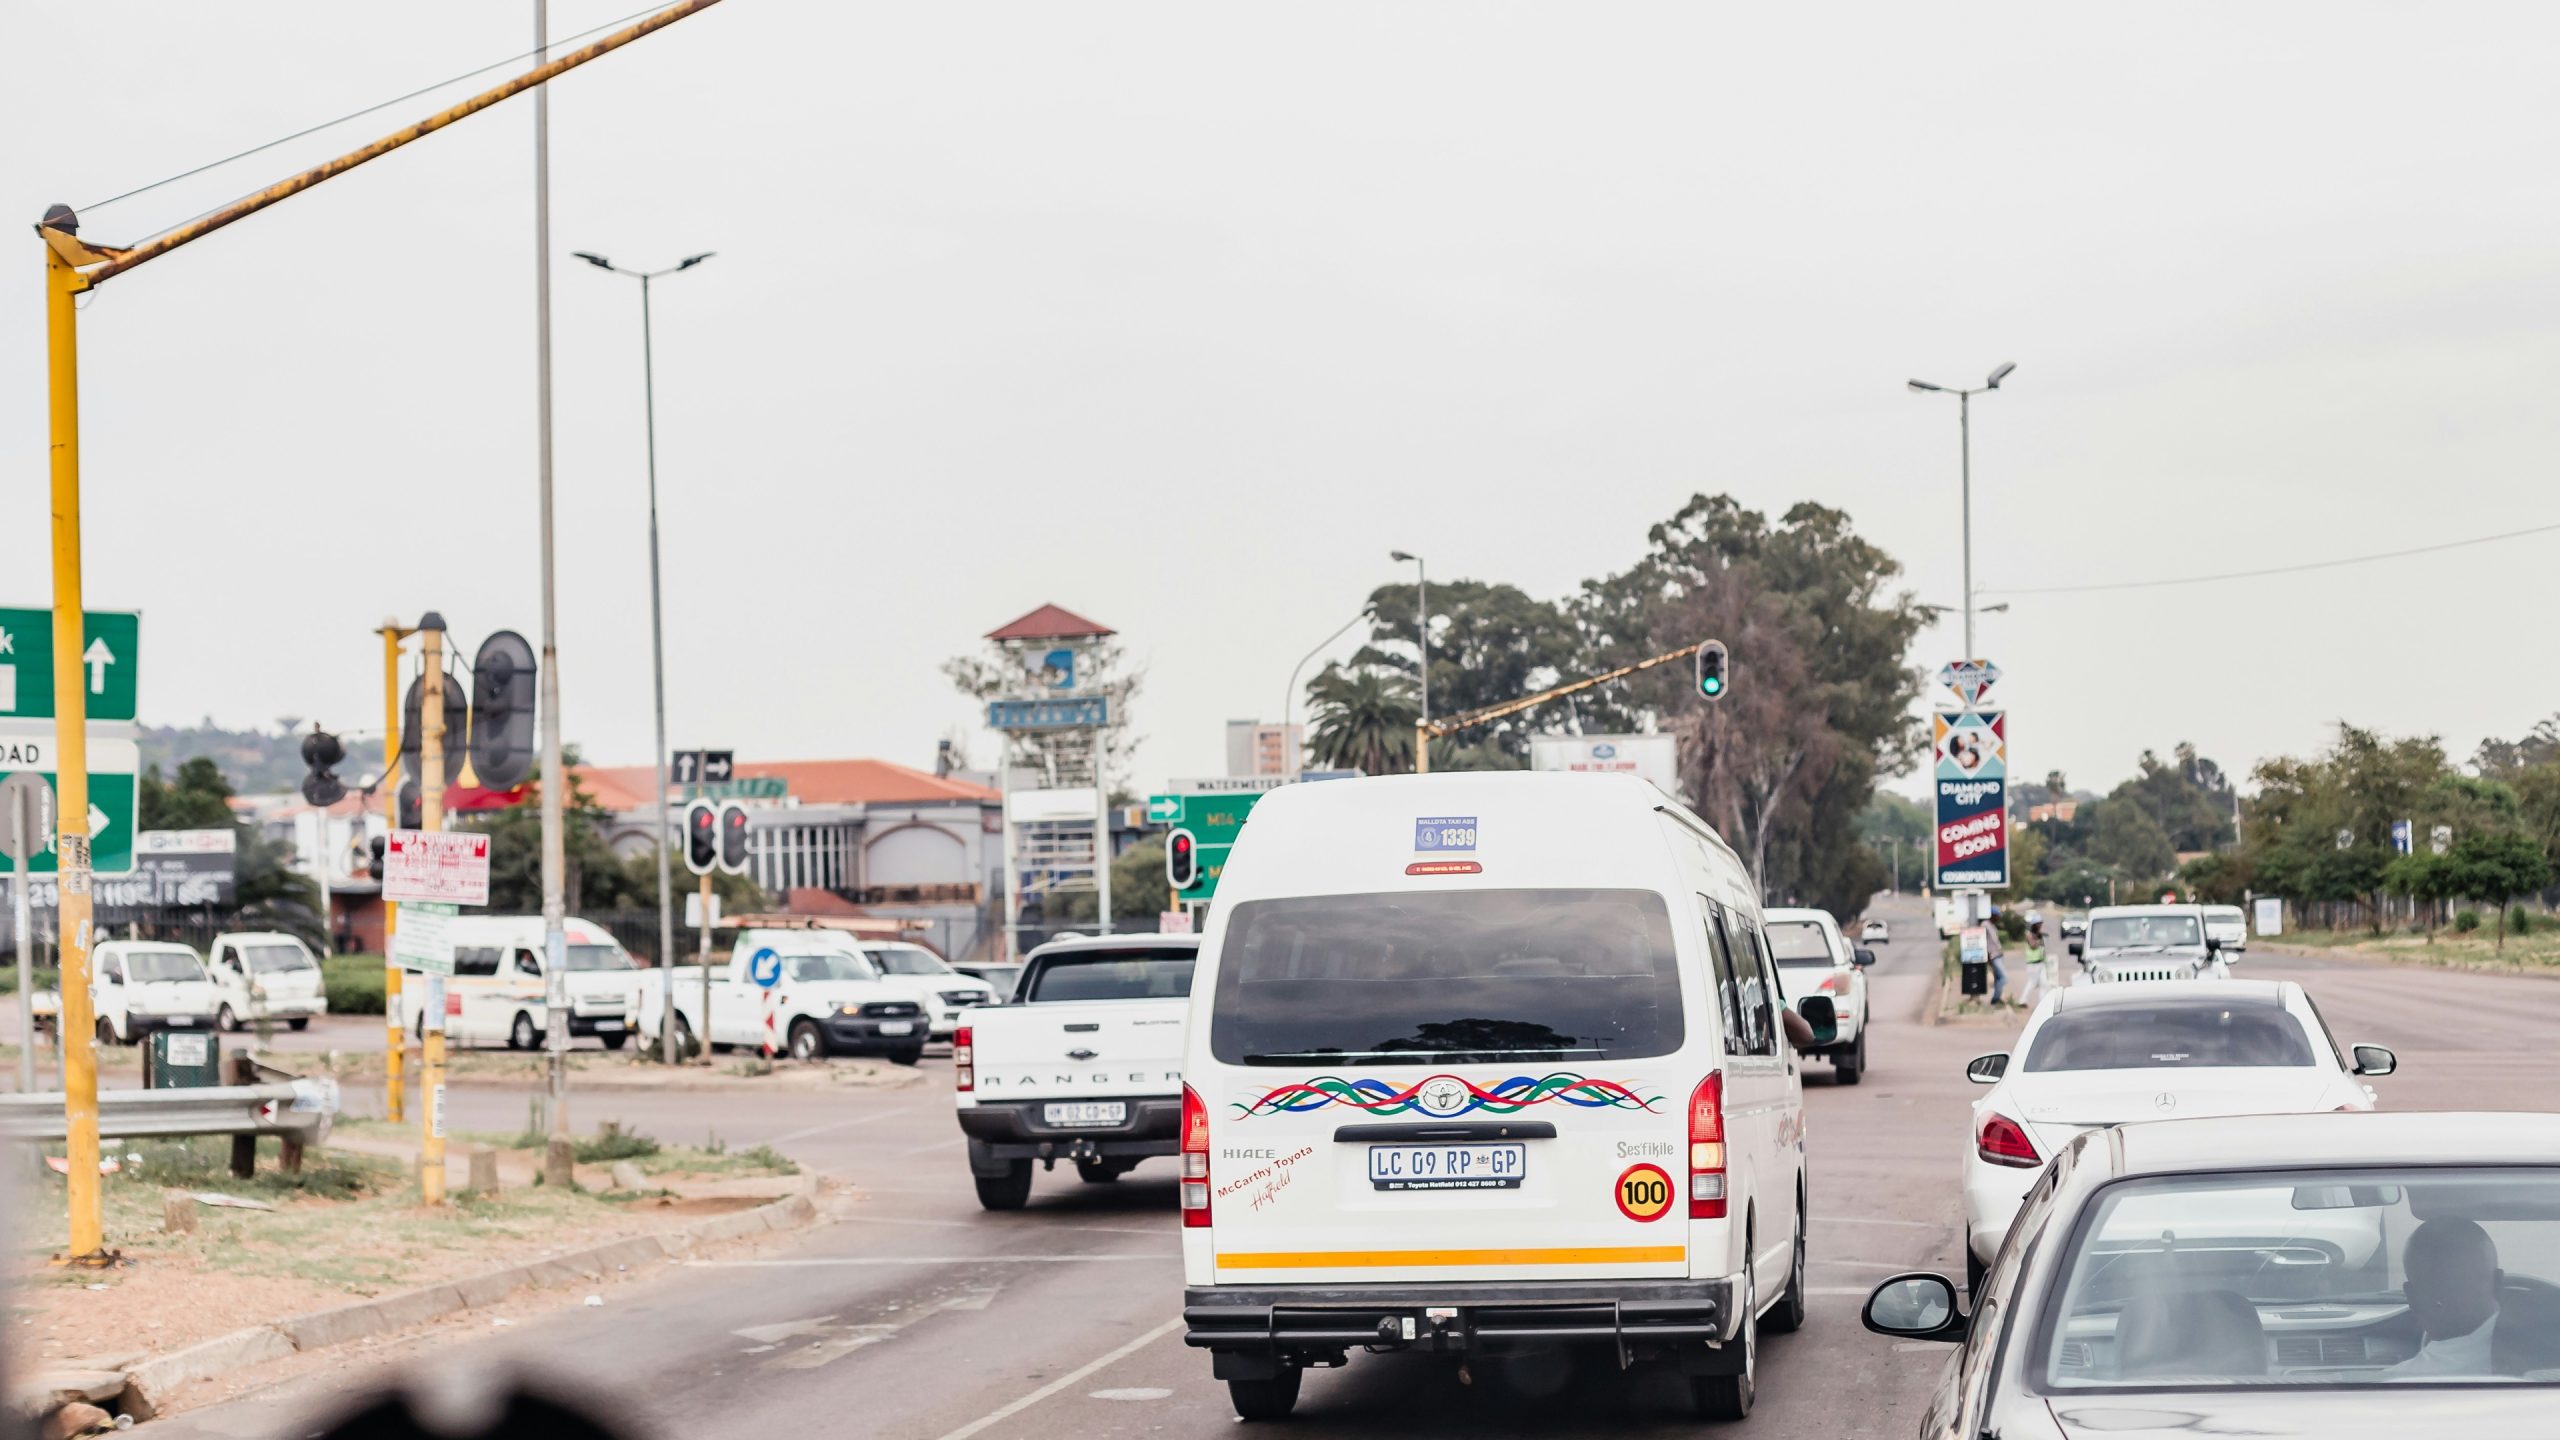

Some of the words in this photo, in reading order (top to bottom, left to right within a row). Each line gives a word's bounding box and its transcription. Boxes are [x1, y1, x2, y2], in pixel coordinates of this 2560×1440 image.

[1940, 781, 2000, 795] DIAMOND
[1955, 792, 1984, 805] CITY
[1441, 828, 1475, 847] 1339
[1941, 813, 2001, 843] COMING
[1953, 832, 1997, 858] SOON
[1941, 870, 2002, 883] COSMOPOLITAN
[985, 1072, 1183, 1086] RANGER
[1223, 1149, 1275, 1158] HIACE
[1377, 1152, 1401, 1175] LC
[1412, 1151, 1436, 1175] 09
[1447, 1150, 1471, 1174] RP
[1492, 1150, 1517, 1173] GP
[1217, 1167, 1271, 1198] McCarthy
[1273, 1146, 1312, 1168] Toyota
[1623, 1181, 1666, 1205] 100
